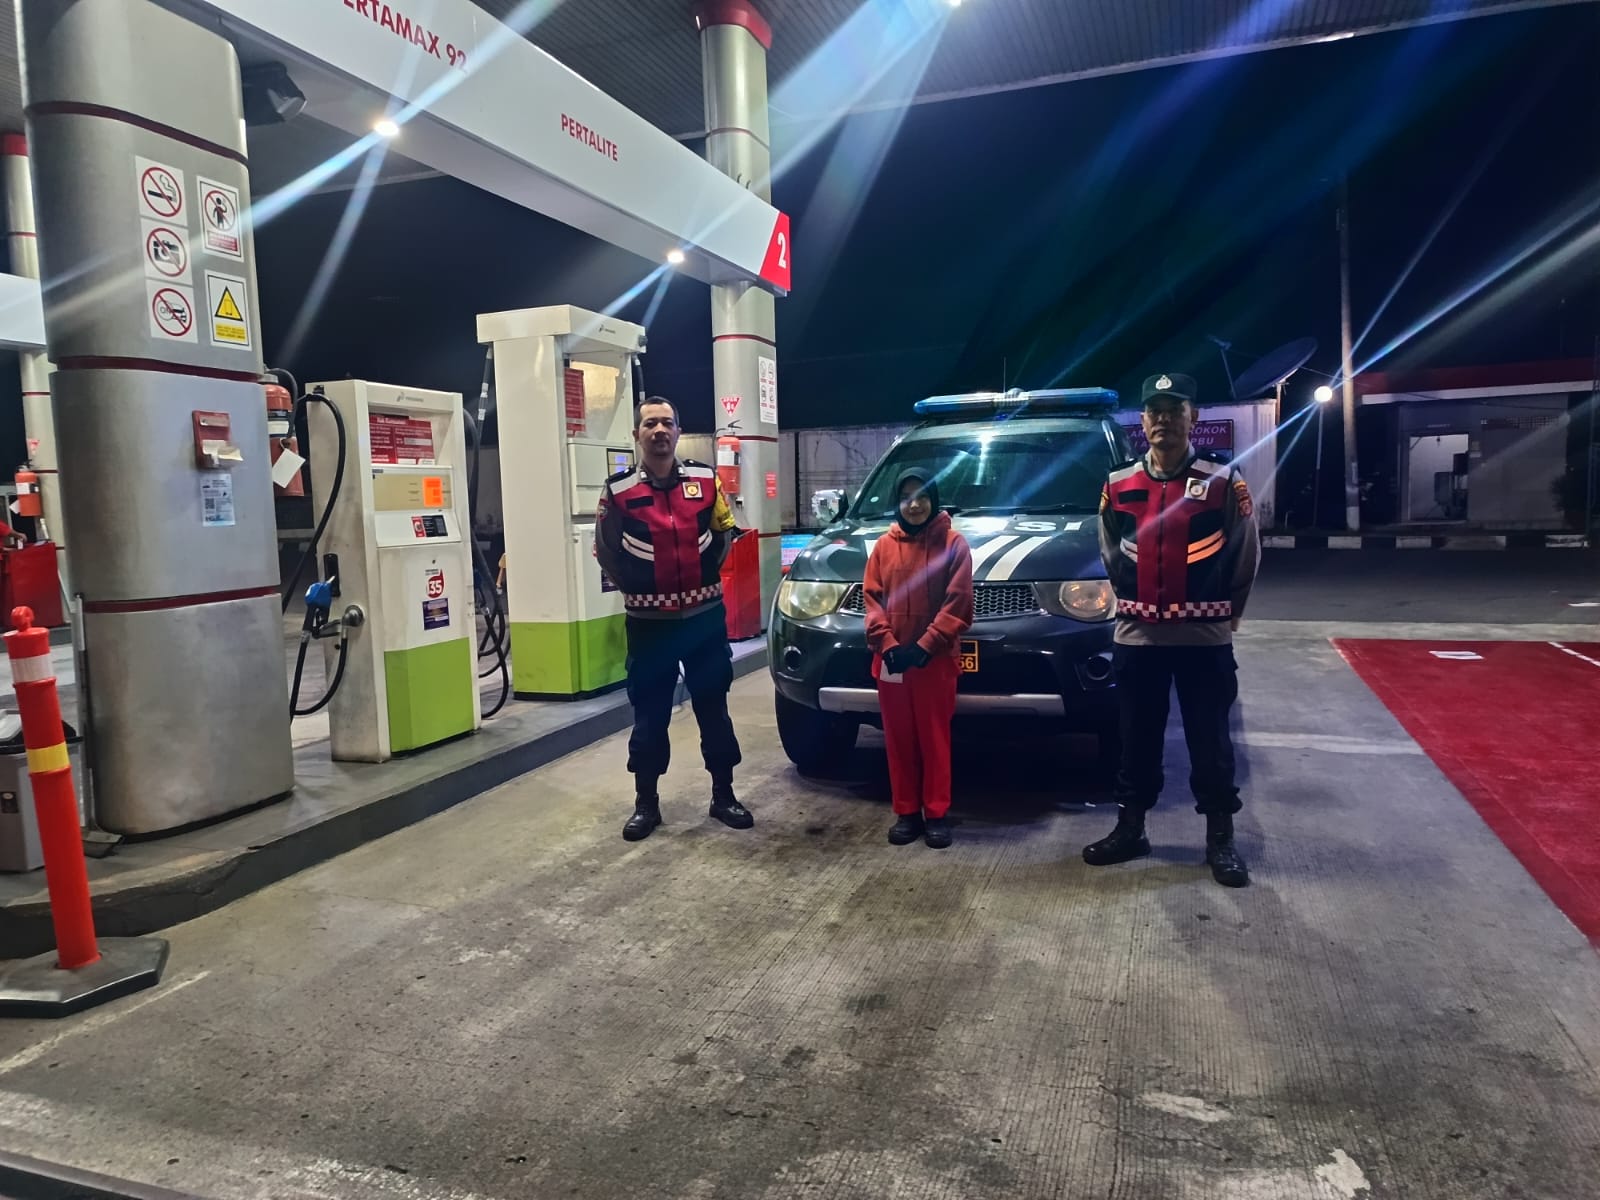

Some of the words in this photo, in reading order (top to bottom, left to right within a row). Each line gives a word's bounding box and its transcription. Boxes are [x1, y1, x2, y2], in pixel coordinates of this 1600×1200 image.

[343, 0, 441, 59] RTAMAX
[561, 113, 618, 162] PERTALITE
[777, 231, 786, 269] 2
